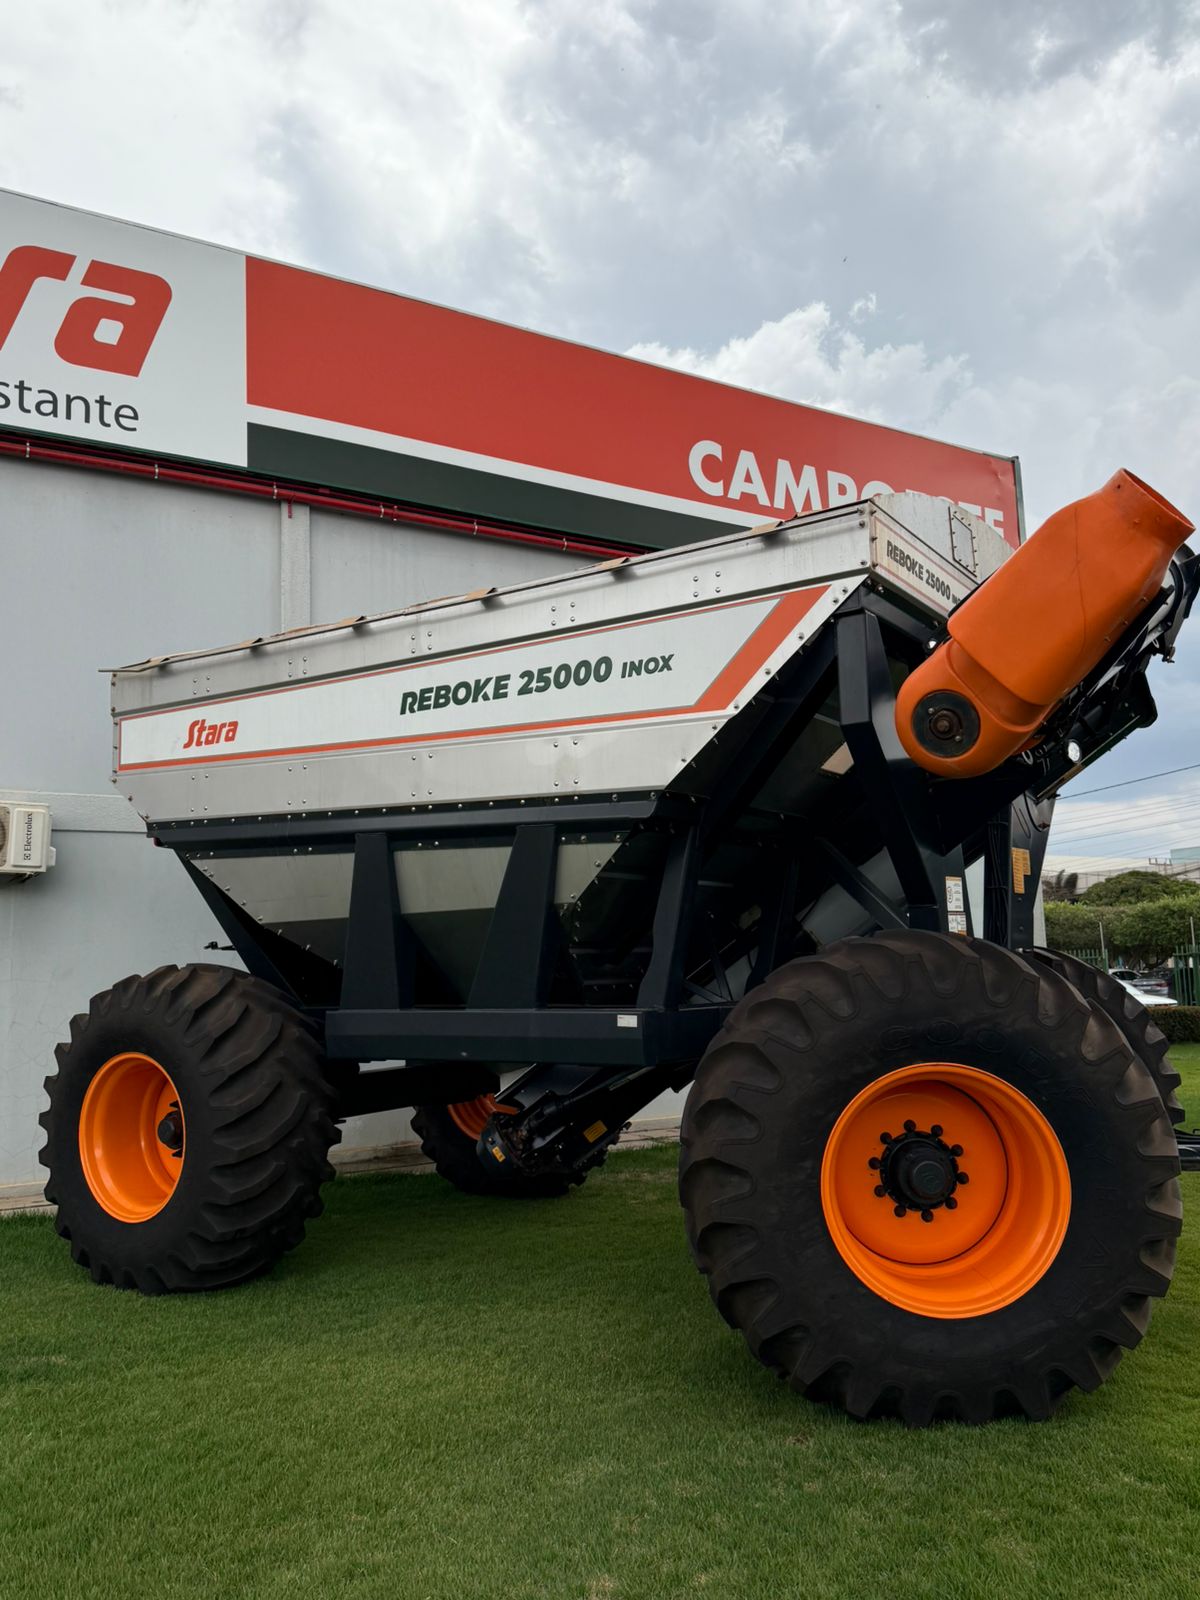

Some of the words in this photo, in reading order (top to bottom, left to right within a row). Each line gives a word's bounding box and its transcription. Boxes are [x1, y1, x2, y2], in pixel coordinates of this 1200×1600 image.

[886, 540, 924, 581] REBOKE
[925, 569, 951, 601] 25000
[400, 674, 511, 715] REBOKE
[517, 656, 613, 696] 25000
[621, 654, 674, 679] INOX
[183, 719, 239, 749] Stara
[24, 813, 33, 852] Electrolux
